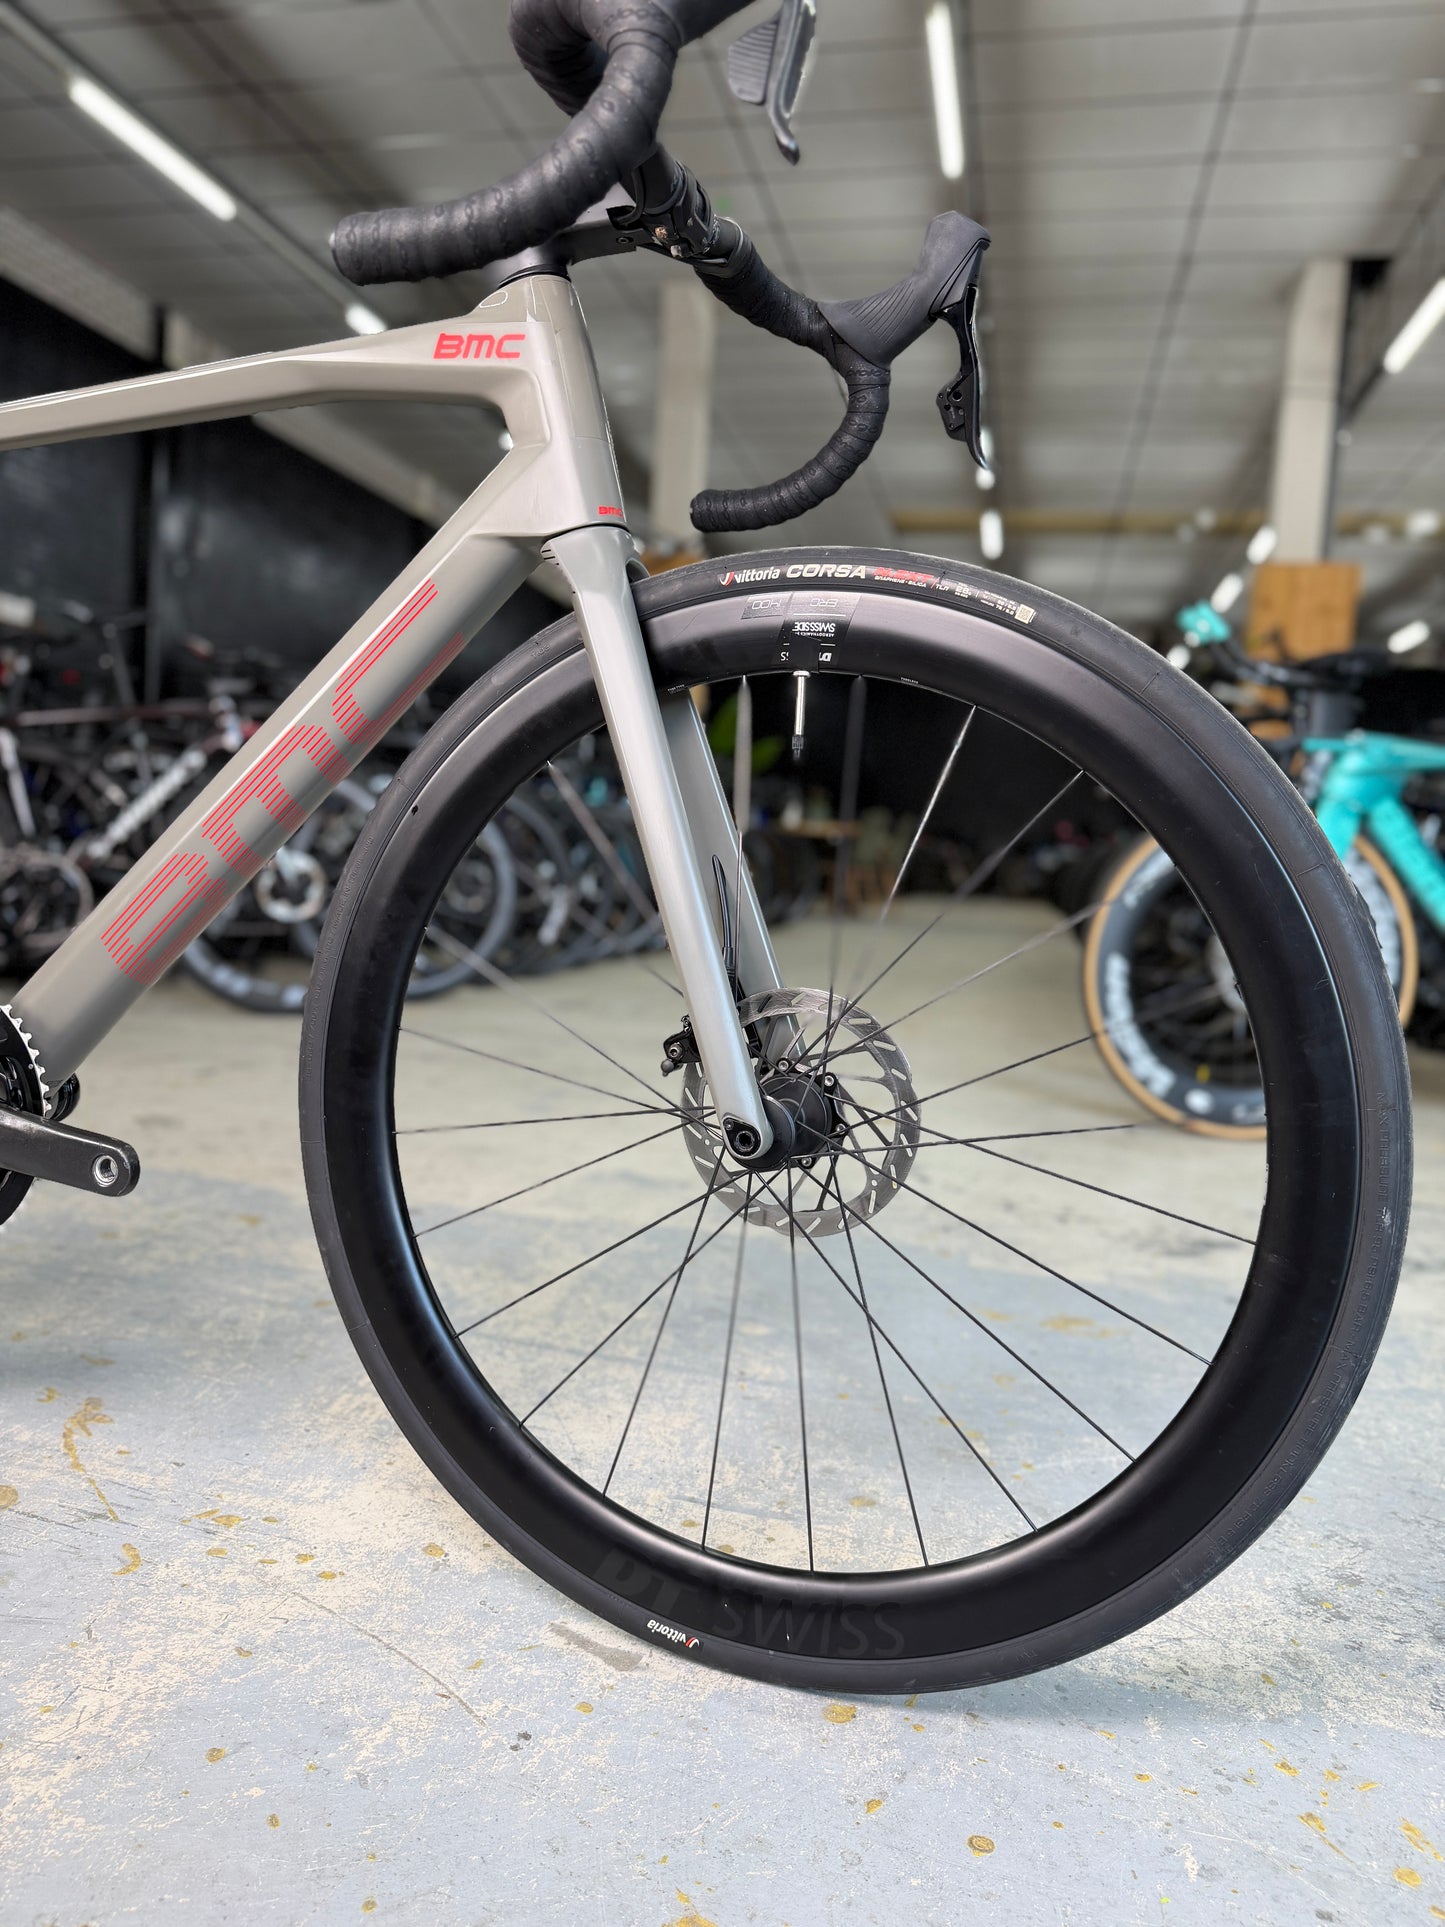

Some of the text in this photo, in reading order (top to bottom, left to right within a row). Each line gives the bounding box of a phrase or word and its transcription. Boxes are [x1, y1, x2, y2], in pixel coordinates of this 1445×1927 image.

[433, 333, 526, 360] BMC
[598, 505, 624, 518] BMC
[734, 565, 781, 584] vittoria
[786, 563, 866, 579] CORSA
[809, 598, 838, 608] ERC
[101, 577, 464, 985] BMC
[646, 1619, 686, 1643] vittoria
